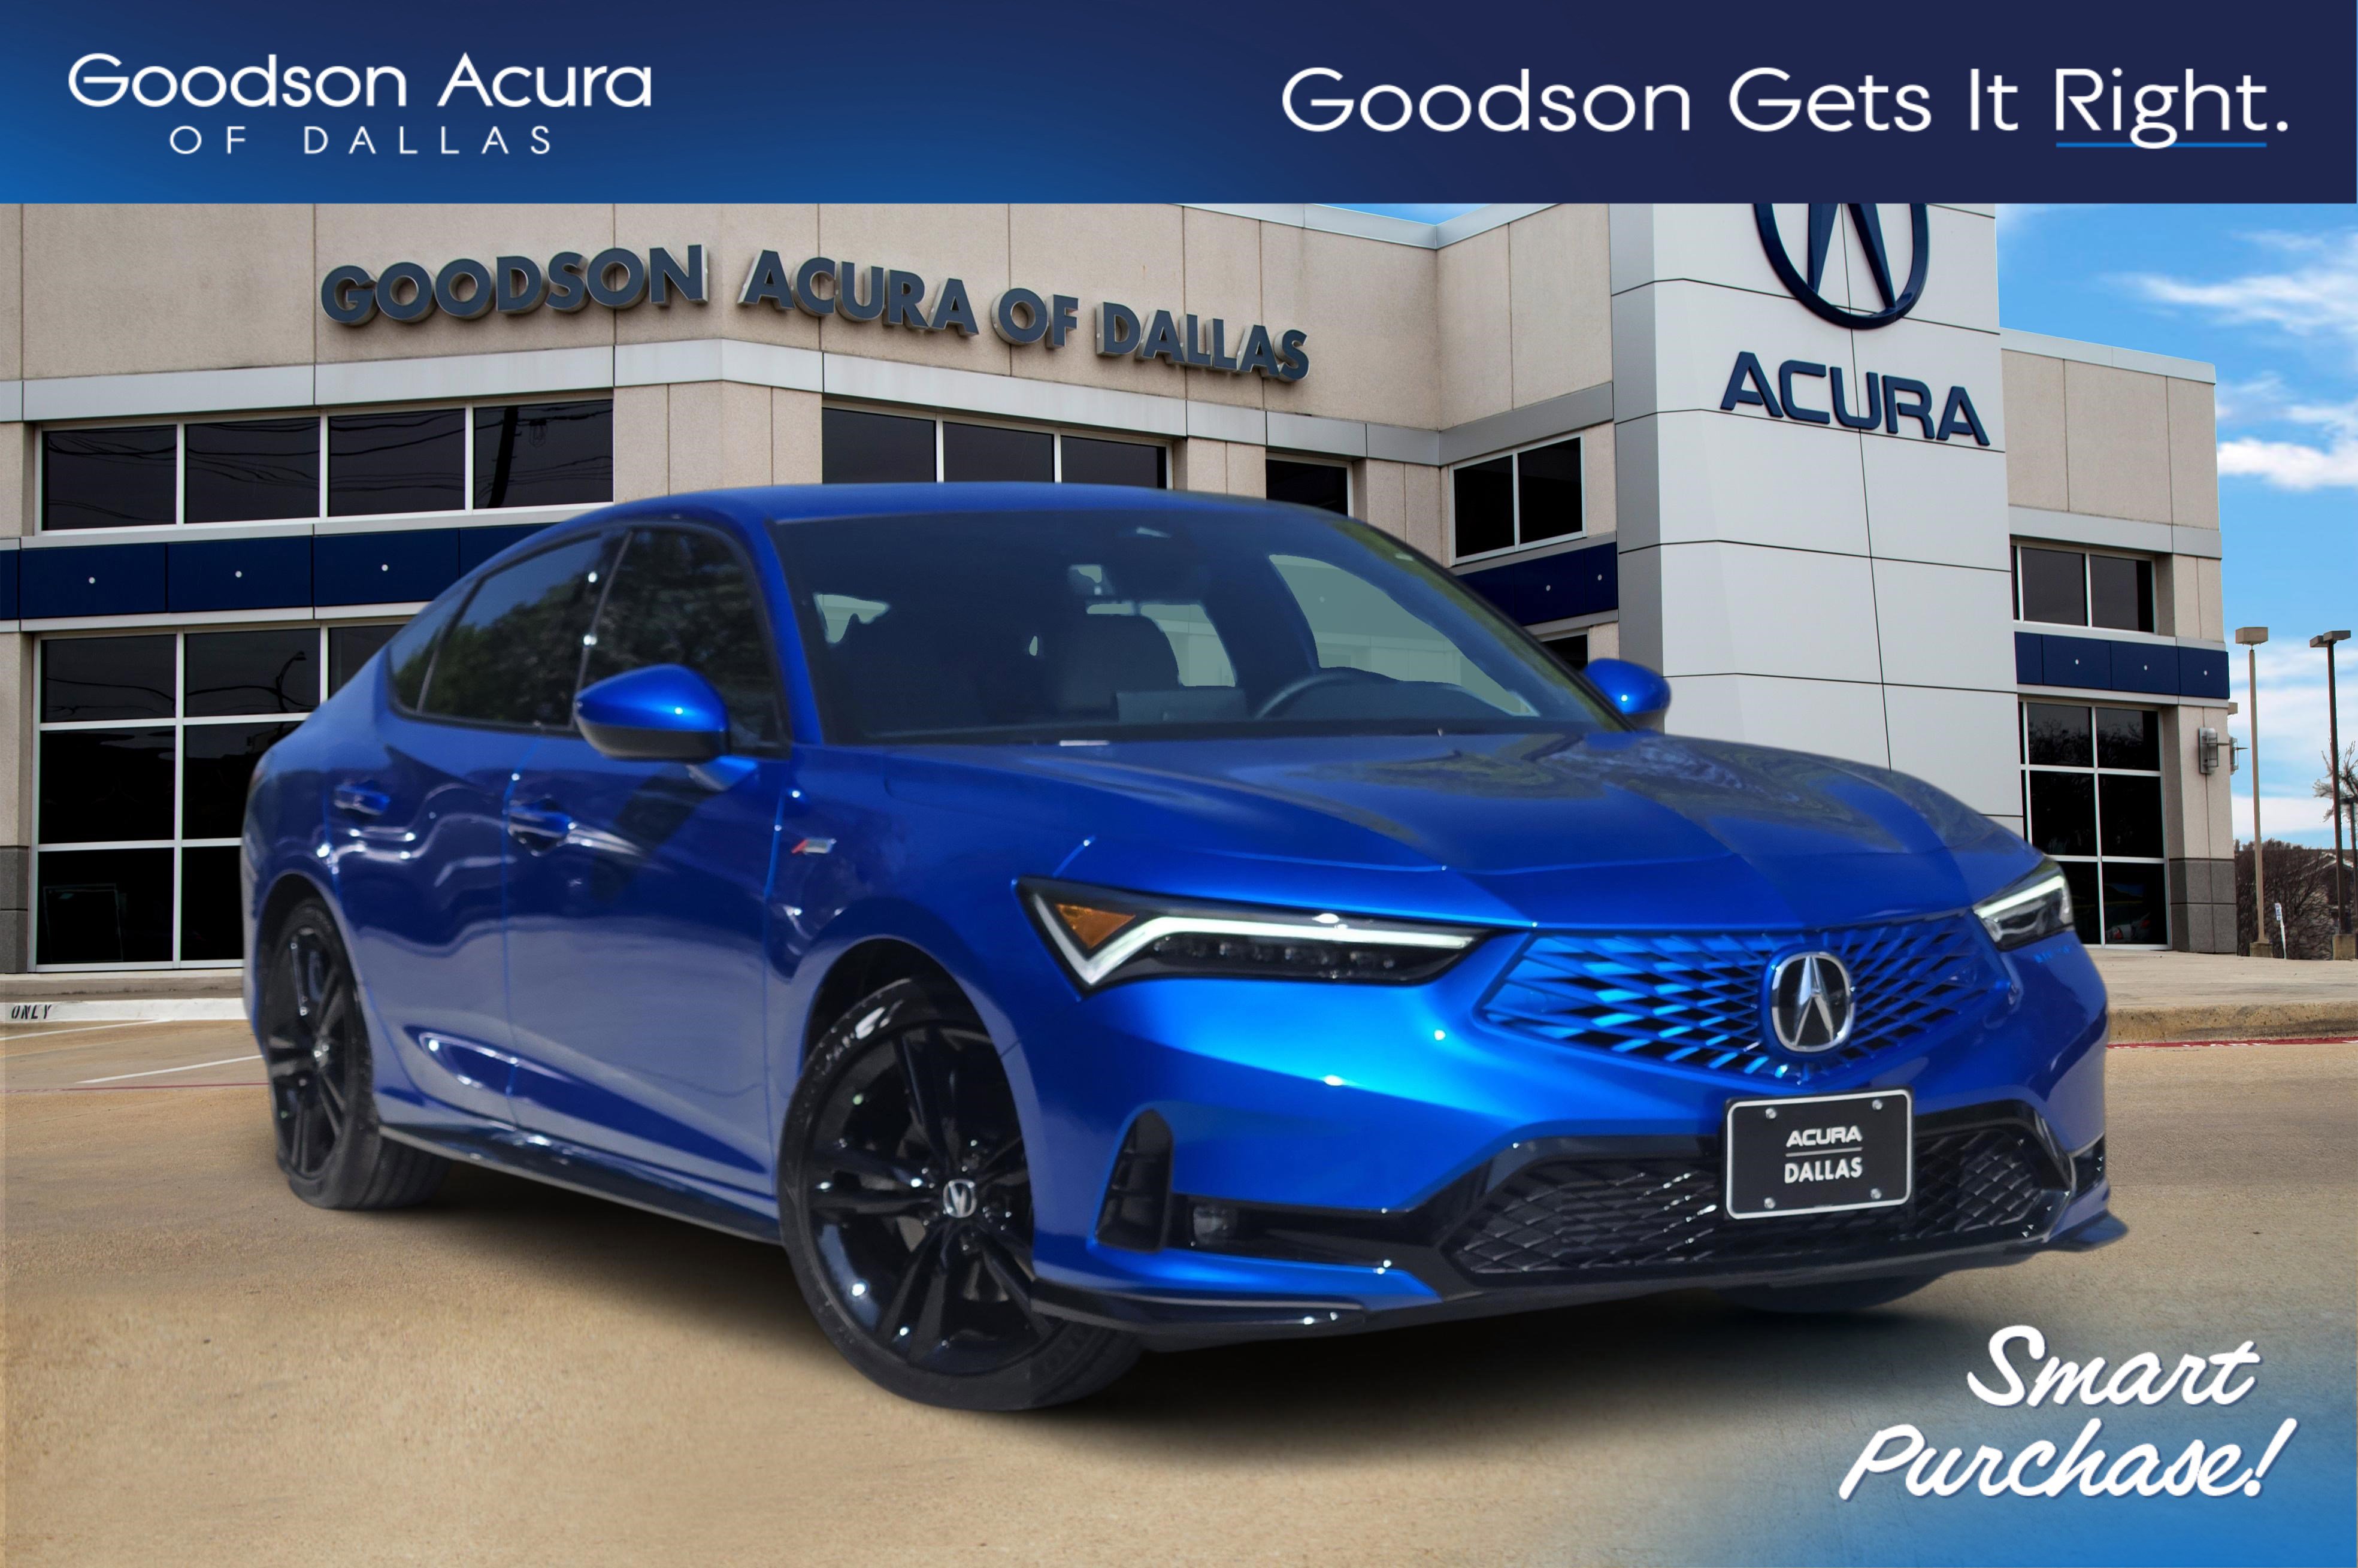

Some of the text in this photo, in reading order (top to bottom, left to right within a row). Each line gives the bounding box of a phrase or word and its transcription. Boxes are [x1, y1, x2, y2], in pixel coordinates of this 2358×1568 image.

[321, 244, 1310, 382] GOODSON ACURA OF DALLAS
[1720, 352, 1990, 447] ACURA
[11, 1004, 52, 1019] ONLY
[1785, 1125, 1863, 1148] ACURA
[1784, 1156, 1863, 1184] DALLAS
